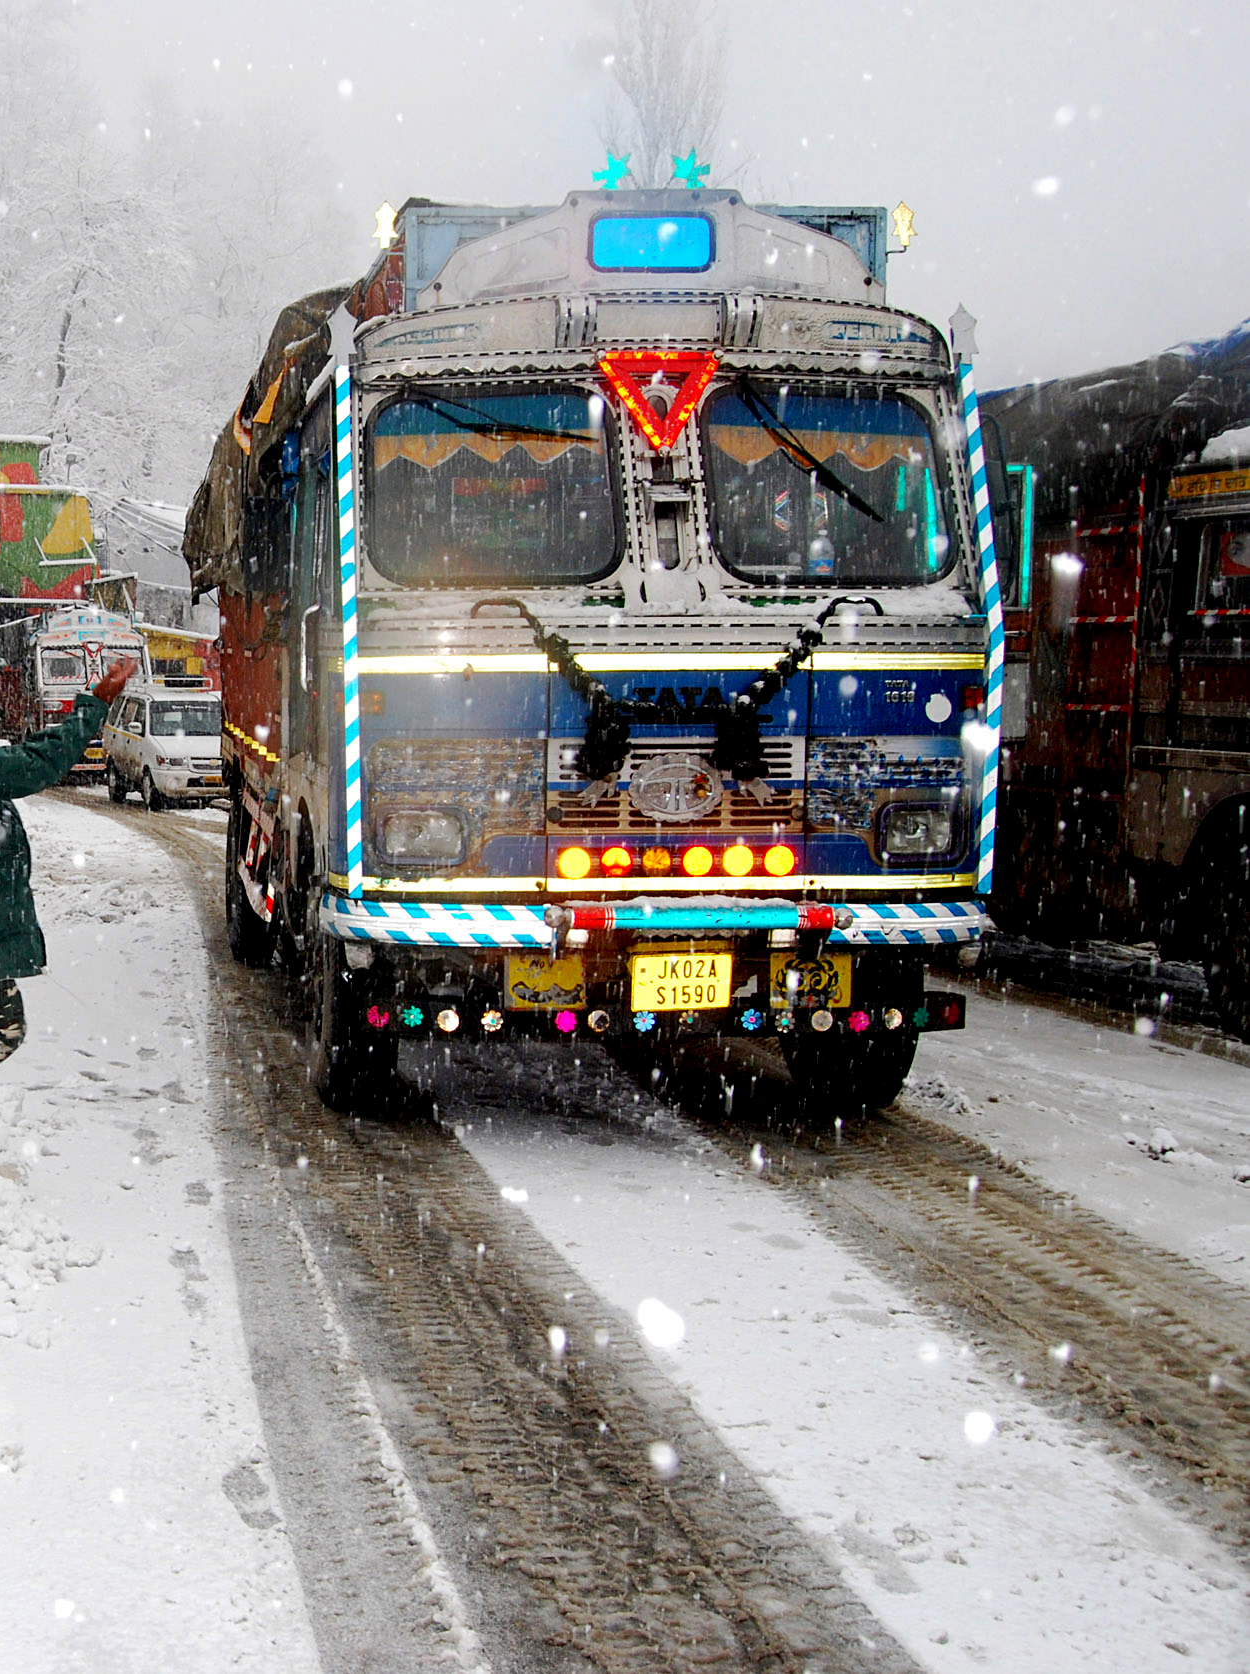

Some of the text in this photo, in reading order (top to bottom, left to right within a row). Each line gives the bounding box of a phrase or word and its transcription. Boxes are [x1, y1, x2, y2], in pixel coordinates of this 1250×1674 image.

[884, 679, 910, 688] TATA
[633, 687, 724, 709] TATA
[658, 959, 717, 979] JK02A
[656, 984, 716, 1006] S1590
